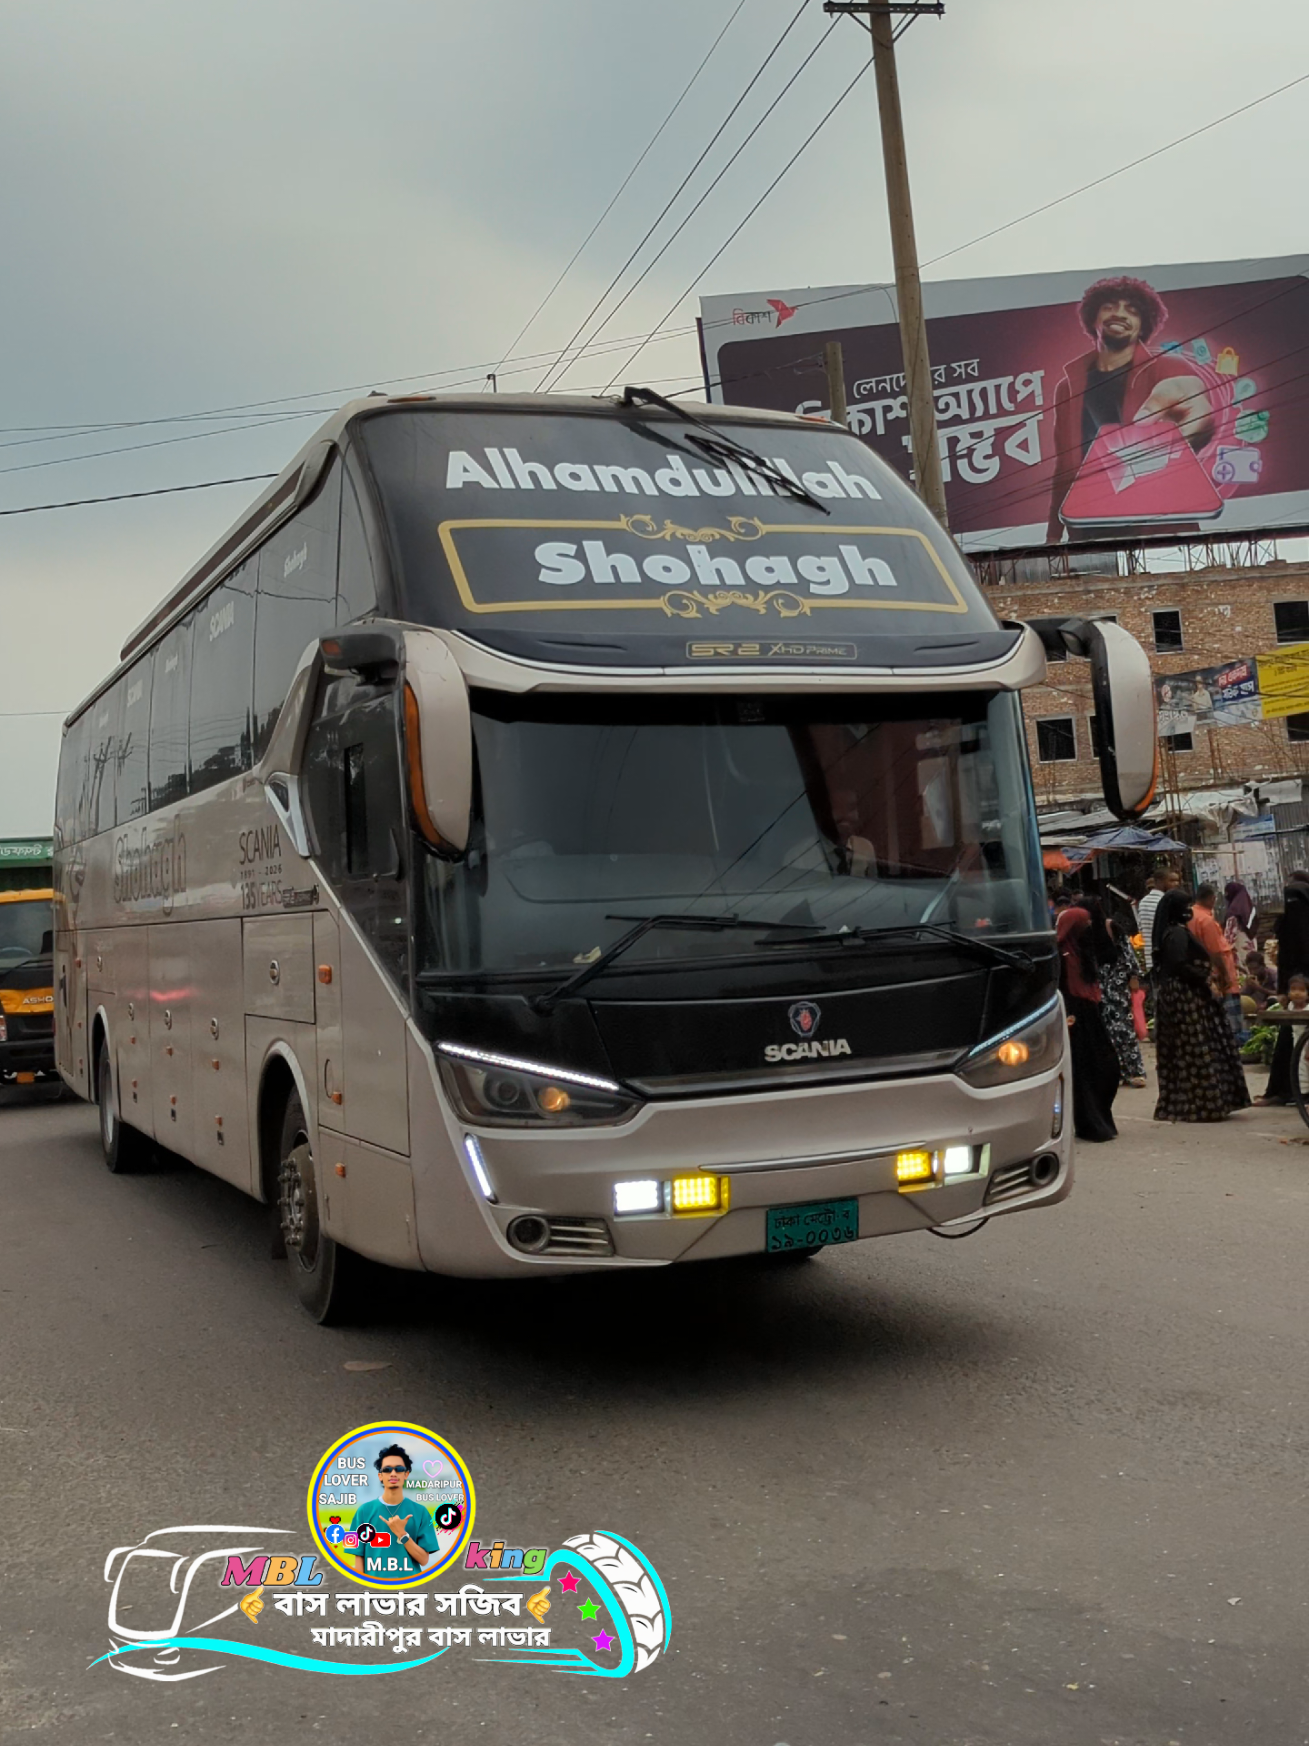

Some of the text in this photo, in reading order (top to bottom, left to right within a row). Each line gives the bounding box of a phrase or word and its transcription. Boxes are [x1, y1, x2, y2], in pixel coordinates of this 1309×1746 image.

[951, 359, 980, 380] সব
[932, 370, 1045, 421] অ্যাপে
[446, 447, 882, 500] Alhamdulillah
[534, 541, 898, 595] Shohagh
[239, 824, 282, 865] SCANIA
[764, 1039, 852, 1062] SCANIA
[774, 1214, 800, 1229] ঢাকা
